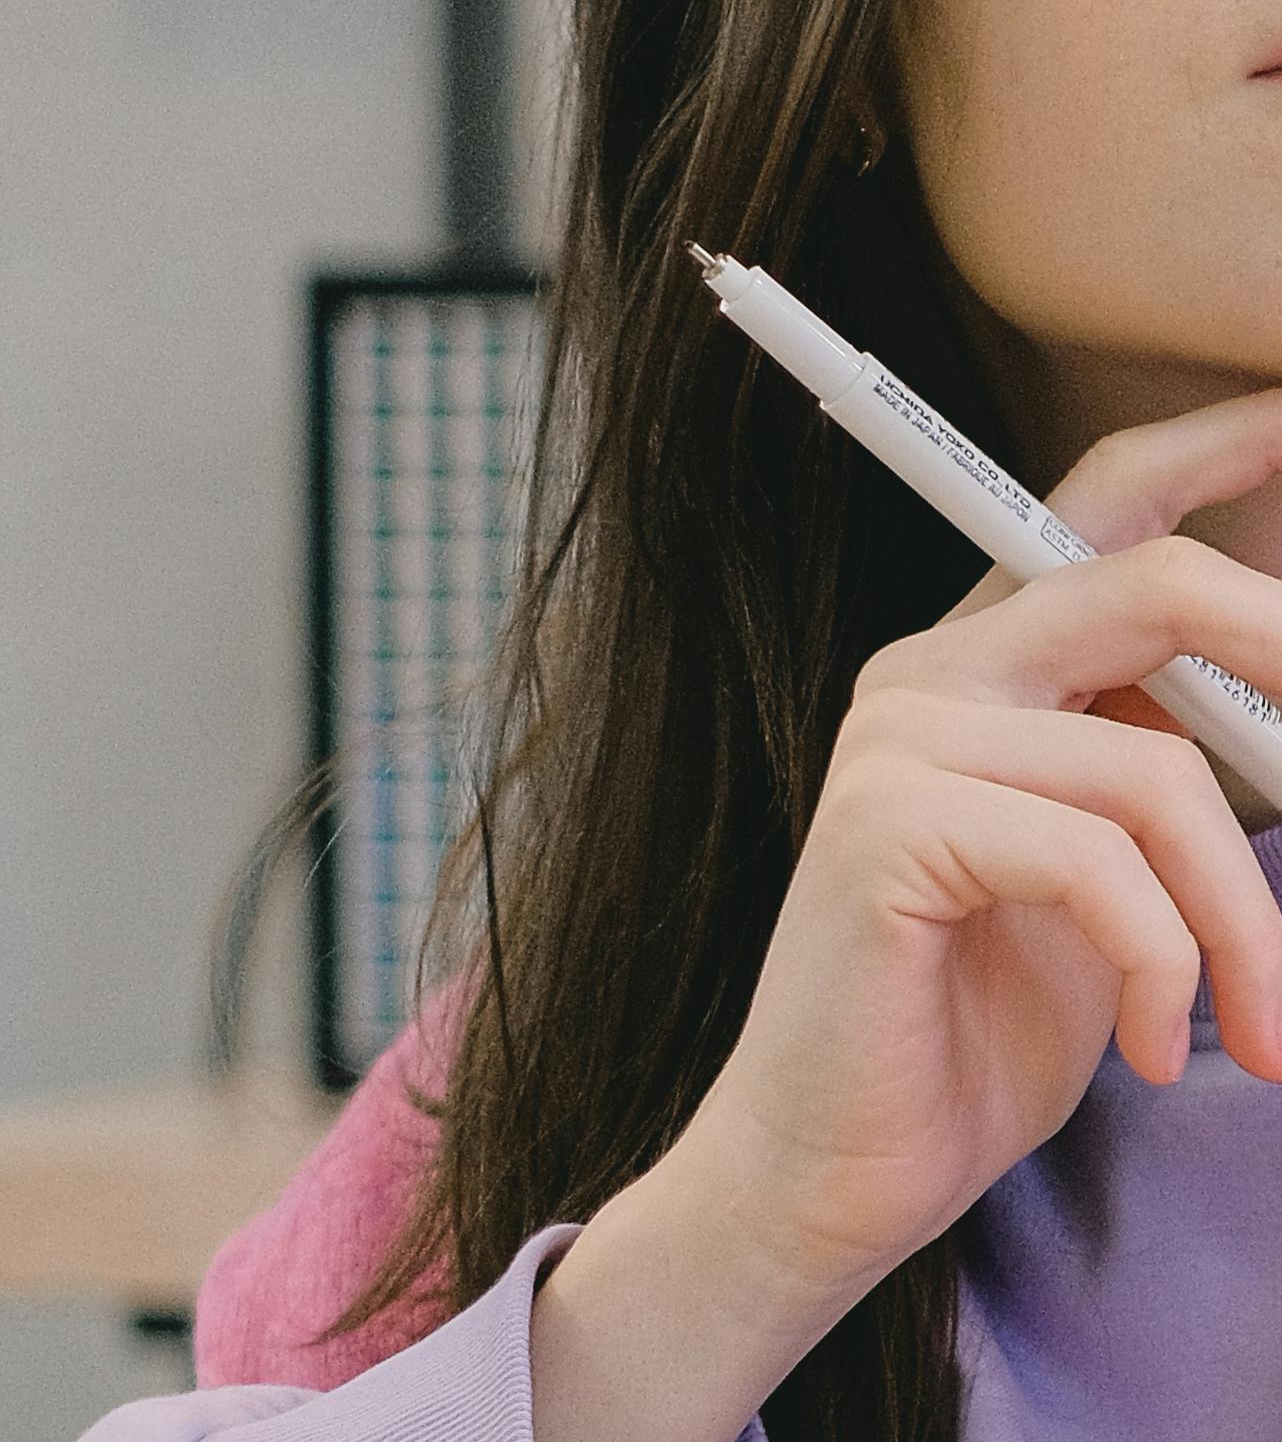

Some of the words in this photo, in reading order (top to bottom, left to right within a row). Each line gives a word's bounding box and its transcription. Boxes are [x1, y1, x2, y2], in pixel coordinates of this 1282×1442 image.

[873, 384, 900, 411] MADE
[912, 417, 942, 446] JAPAN
[946, 446, 990, 488] FABRIQUE
[880, 374, 933, 426] UCHIDA
[938, 423, 975, 460] YOKO
[1044, 528, 1070, 551] ASTM
